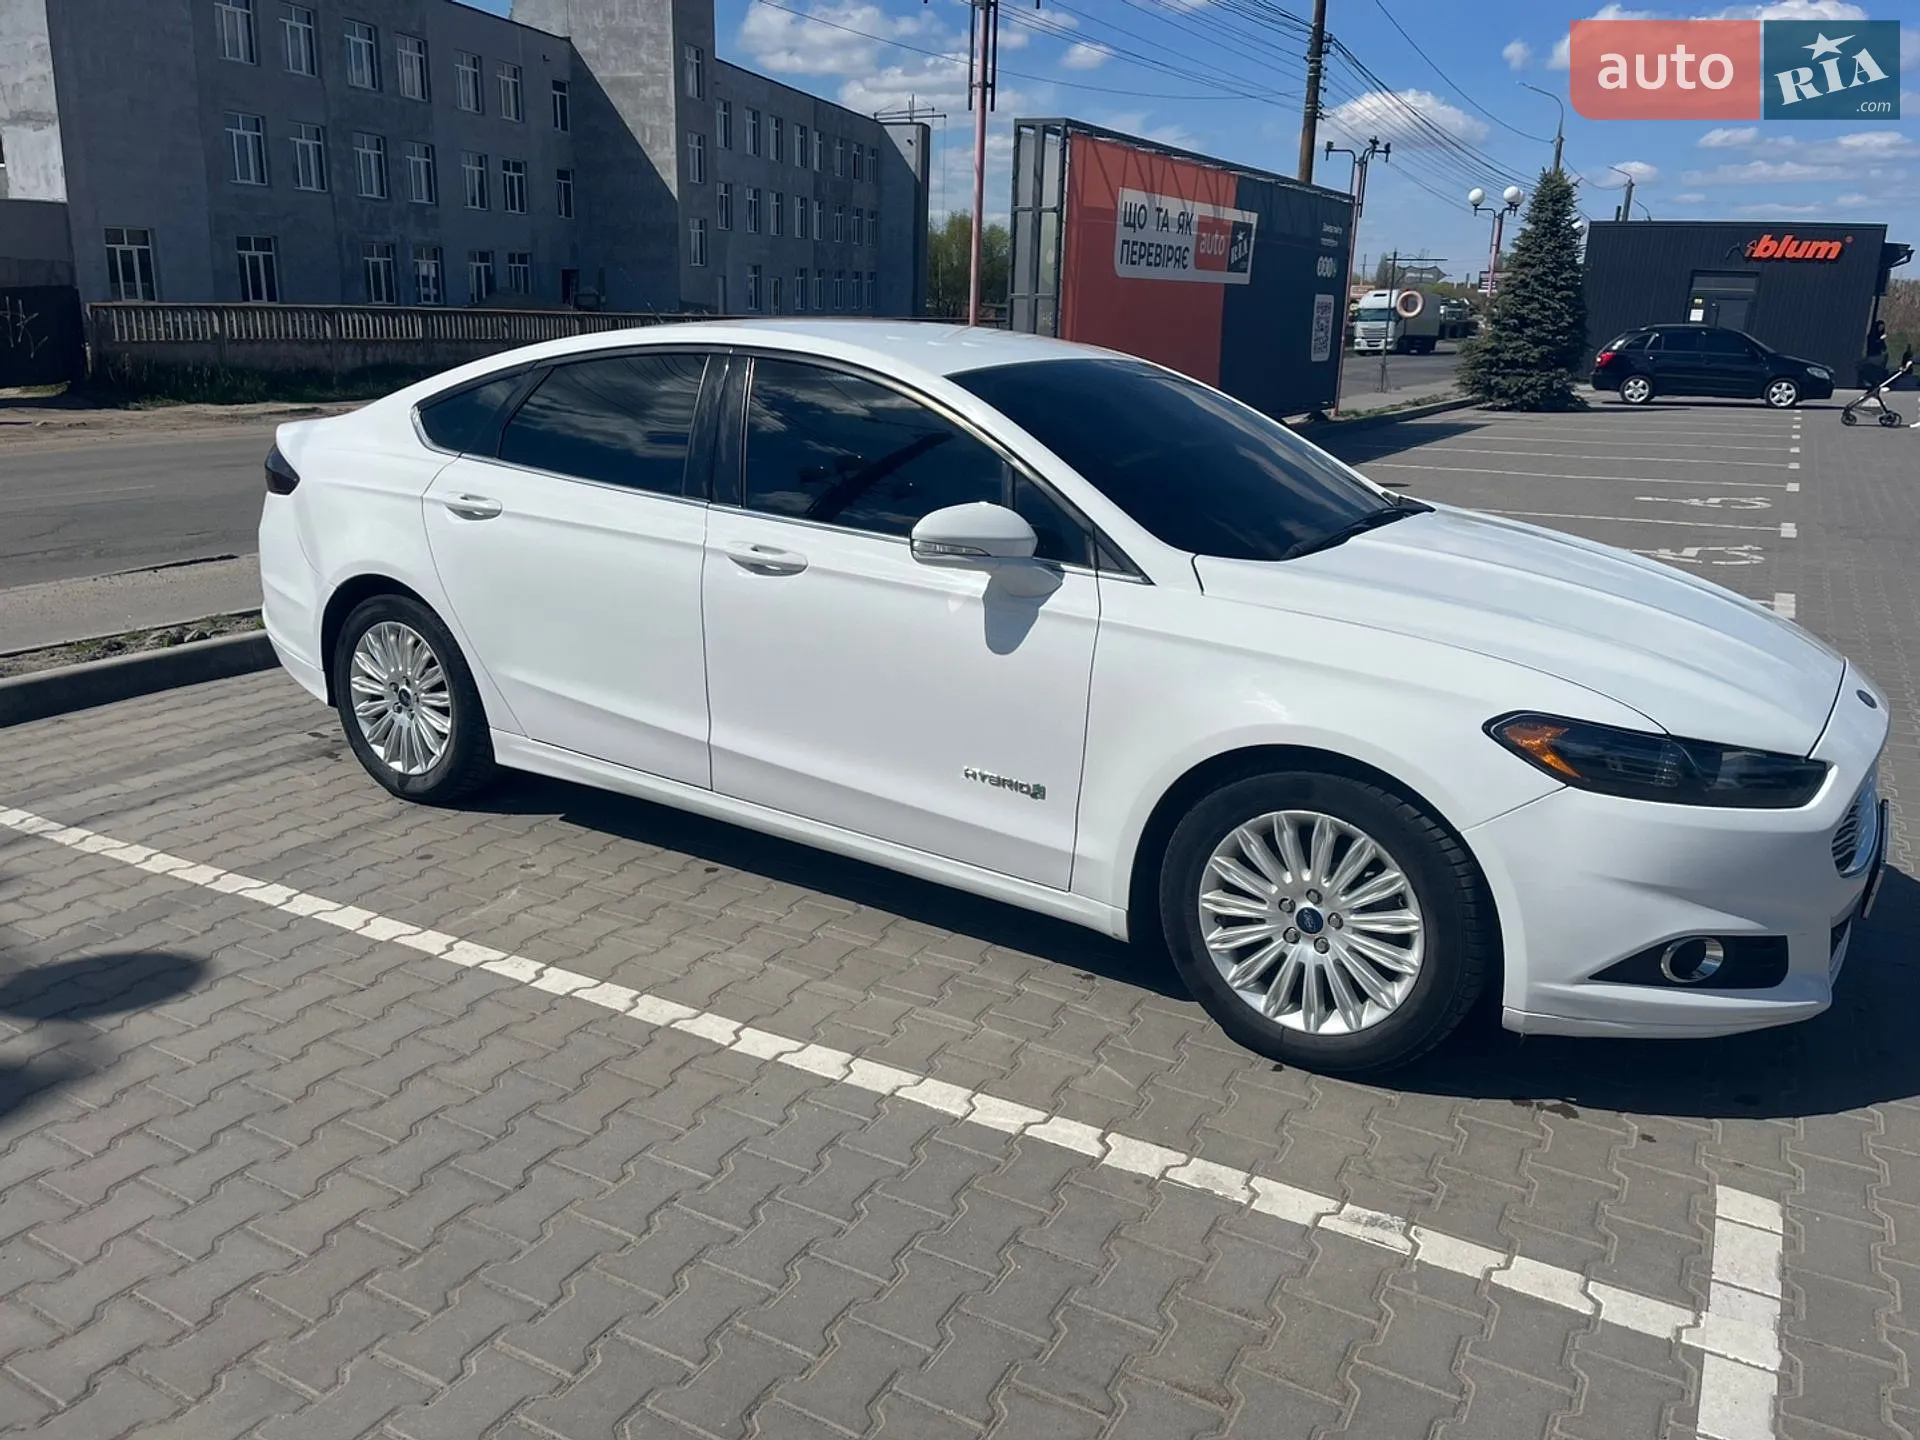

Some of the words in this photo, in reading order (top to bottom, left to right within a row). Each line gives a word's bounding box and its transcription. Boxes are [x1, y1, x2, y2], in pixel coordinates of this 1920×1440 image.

[1123, 201, 1148, 233] ЩО
[1155, 206, 1169, 233] ТА
[1177, 211, 1194, 236] ЯК
[1120, 239, 1190, 270] ПЕРЕВІРЯЄ
[1199, 230, 1225, 256] auto
[1230, 238, 1249, 265] RIA
[1752, 234, 1842, 259] blum
[963, 766, 1031, 796] HYBRID
